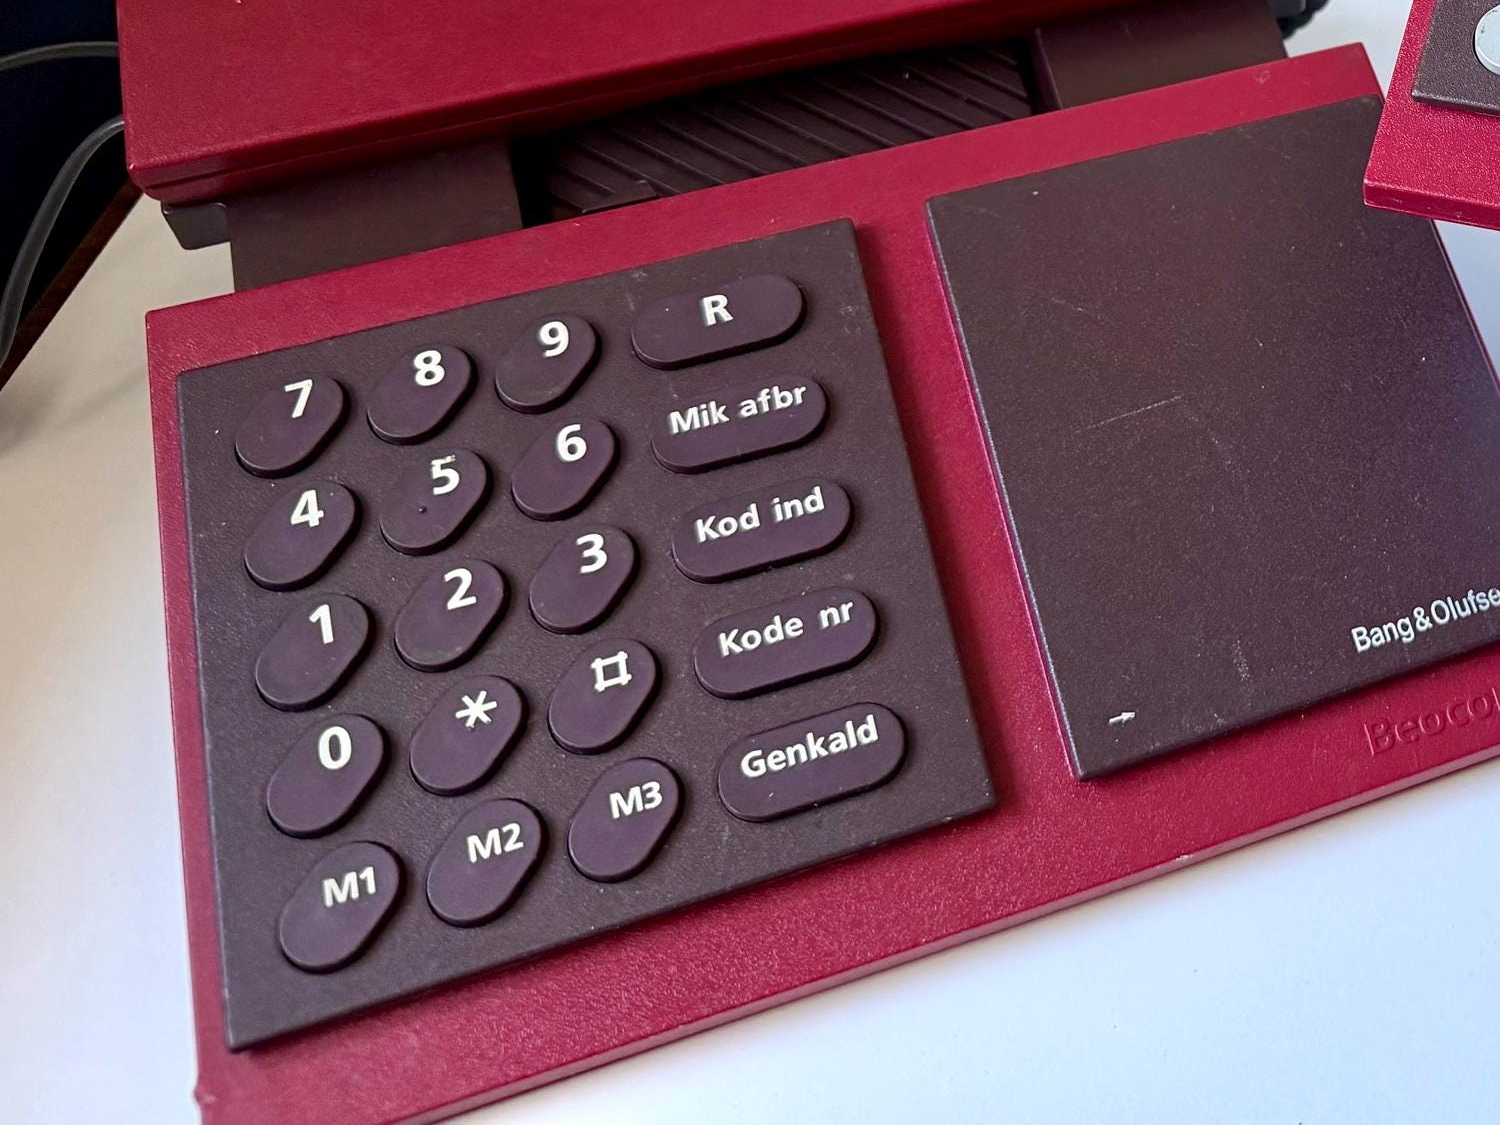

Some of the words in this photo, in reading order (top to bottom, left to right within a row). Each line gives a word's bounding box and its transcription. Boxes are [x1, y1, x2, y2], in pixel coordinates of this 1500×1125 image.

[703, 295, 733, 325] R
[539, 322, 568, 356] 9
[414, 350, 444, 386] 8
[285, 379, 312, 418] 7
[670, 401, 729, 434] Mik
[740, 386, 806, 417] afbr
[557, 424, 586, 461] 6
[432, 455, 459, 495] 5
[291, 490, 324, 527] 4
[696, 504, 760, 542] Kod
[773, 486, 824, 521] ind
[577, 534, 607, 573] 3
[445, 569, 476, 610] 2
[309, 605, 333, 643] 1
[719, 616, 803, 656] Kode
[820, 602, 852, 628] nr
[319, 727, 351, 769] 0
[741, 715, 878, 777] Genkald
[610, 782, 662, 818] M3
[468, 823, 523, 863] M2
[324, 867, 375, 907] M1
